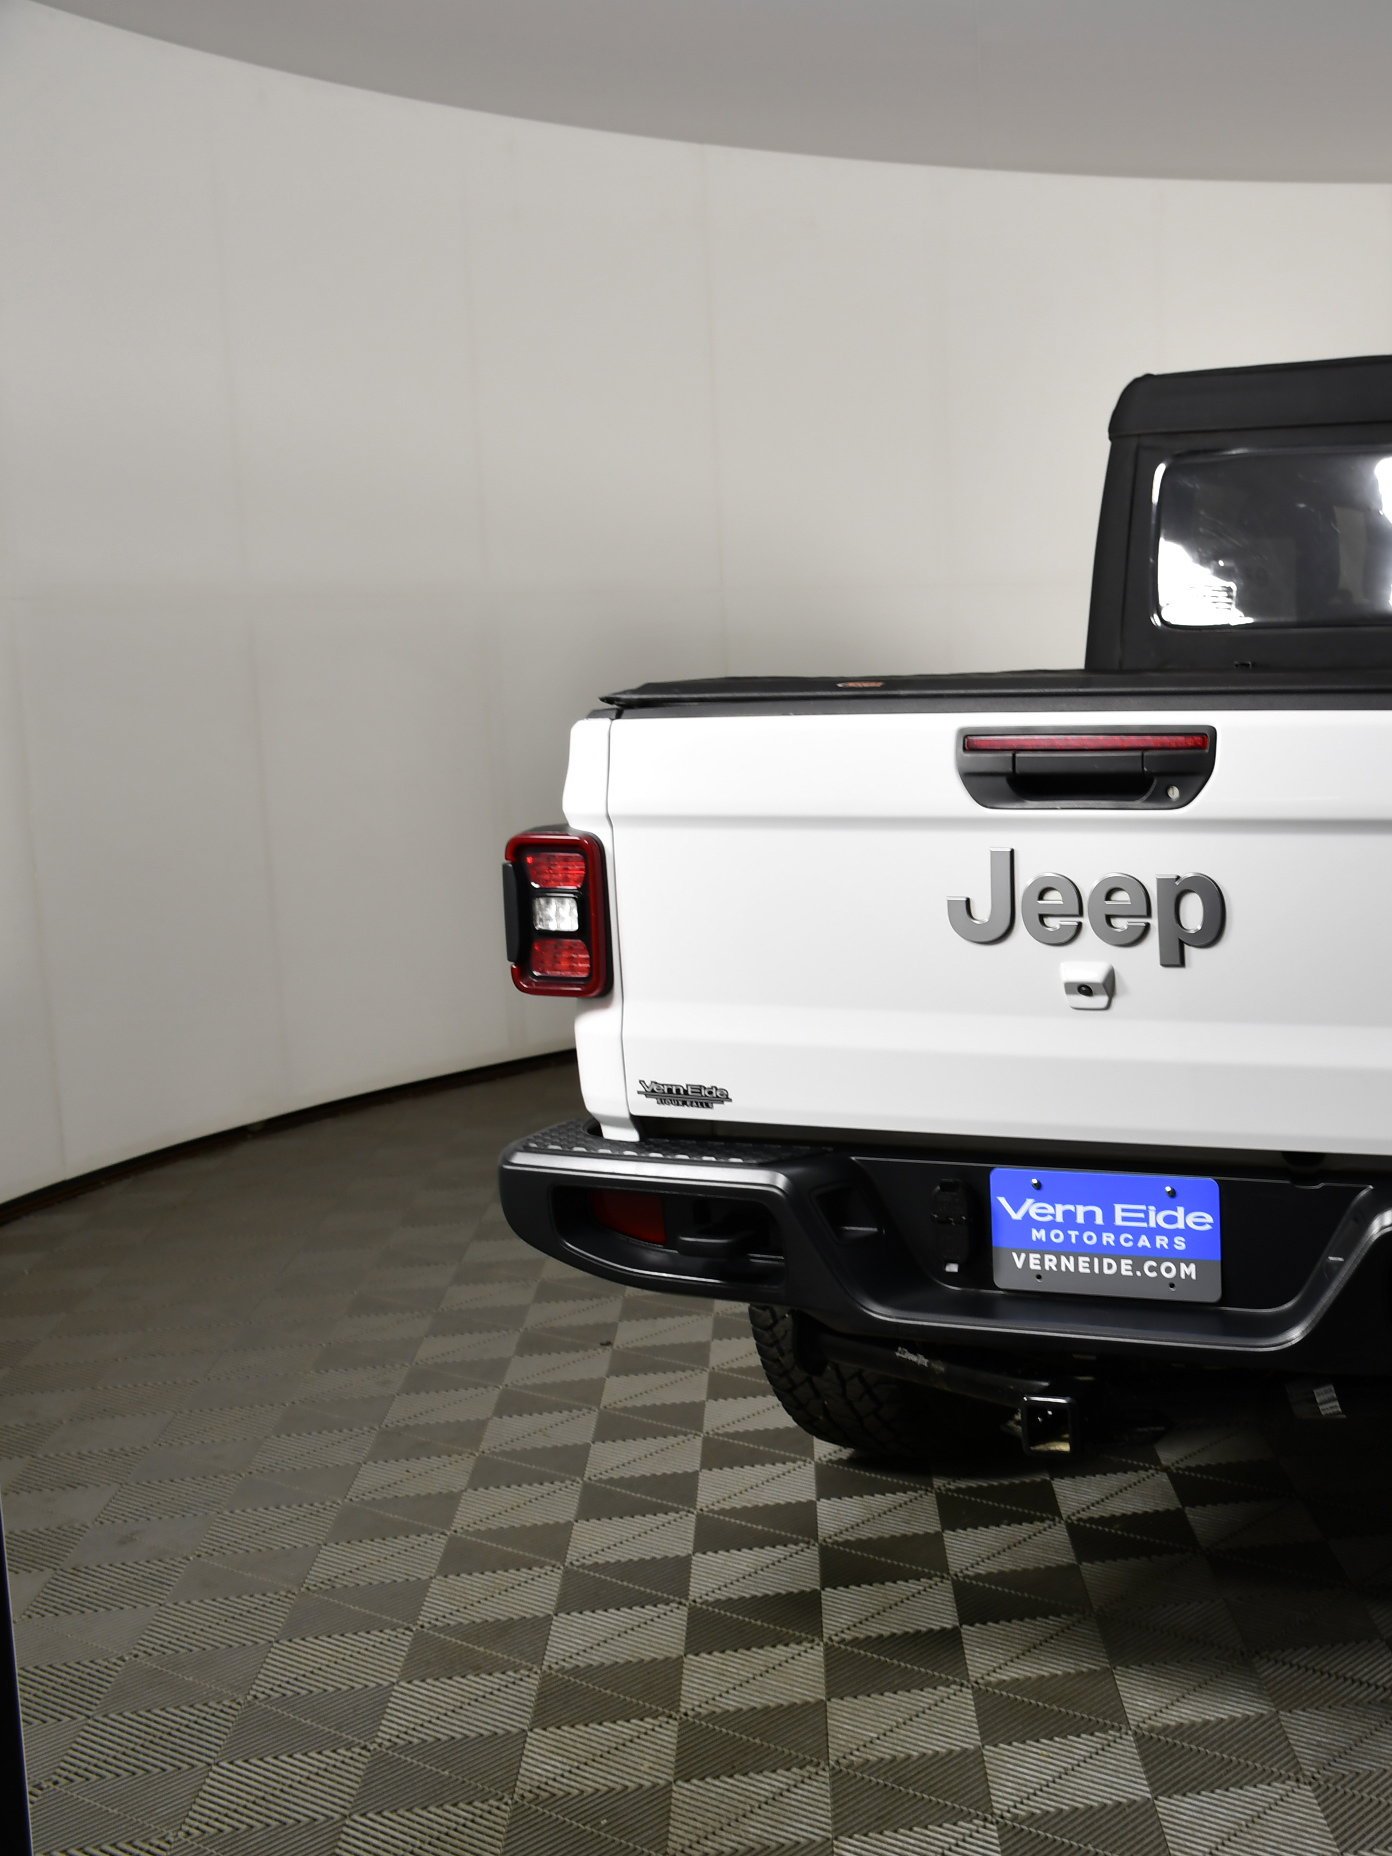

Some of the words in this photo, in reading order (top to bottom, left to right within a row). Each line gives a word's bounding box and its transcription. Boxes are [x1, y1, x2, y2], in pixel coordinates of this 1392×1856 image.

[947, 847, 1226, 968] Jeep
[638, 1080, 687, 1094] Vern
[686, 1084, 729, 1099] Eide
[996, 1196, 1104, 1226] Vern
[1113, 1203, 1214, 1231] Eide
[1031, 1227, 1187, 1251] MOTORCARS
[1011, 1251, 1197, 1280] VERNEIDE.COM
